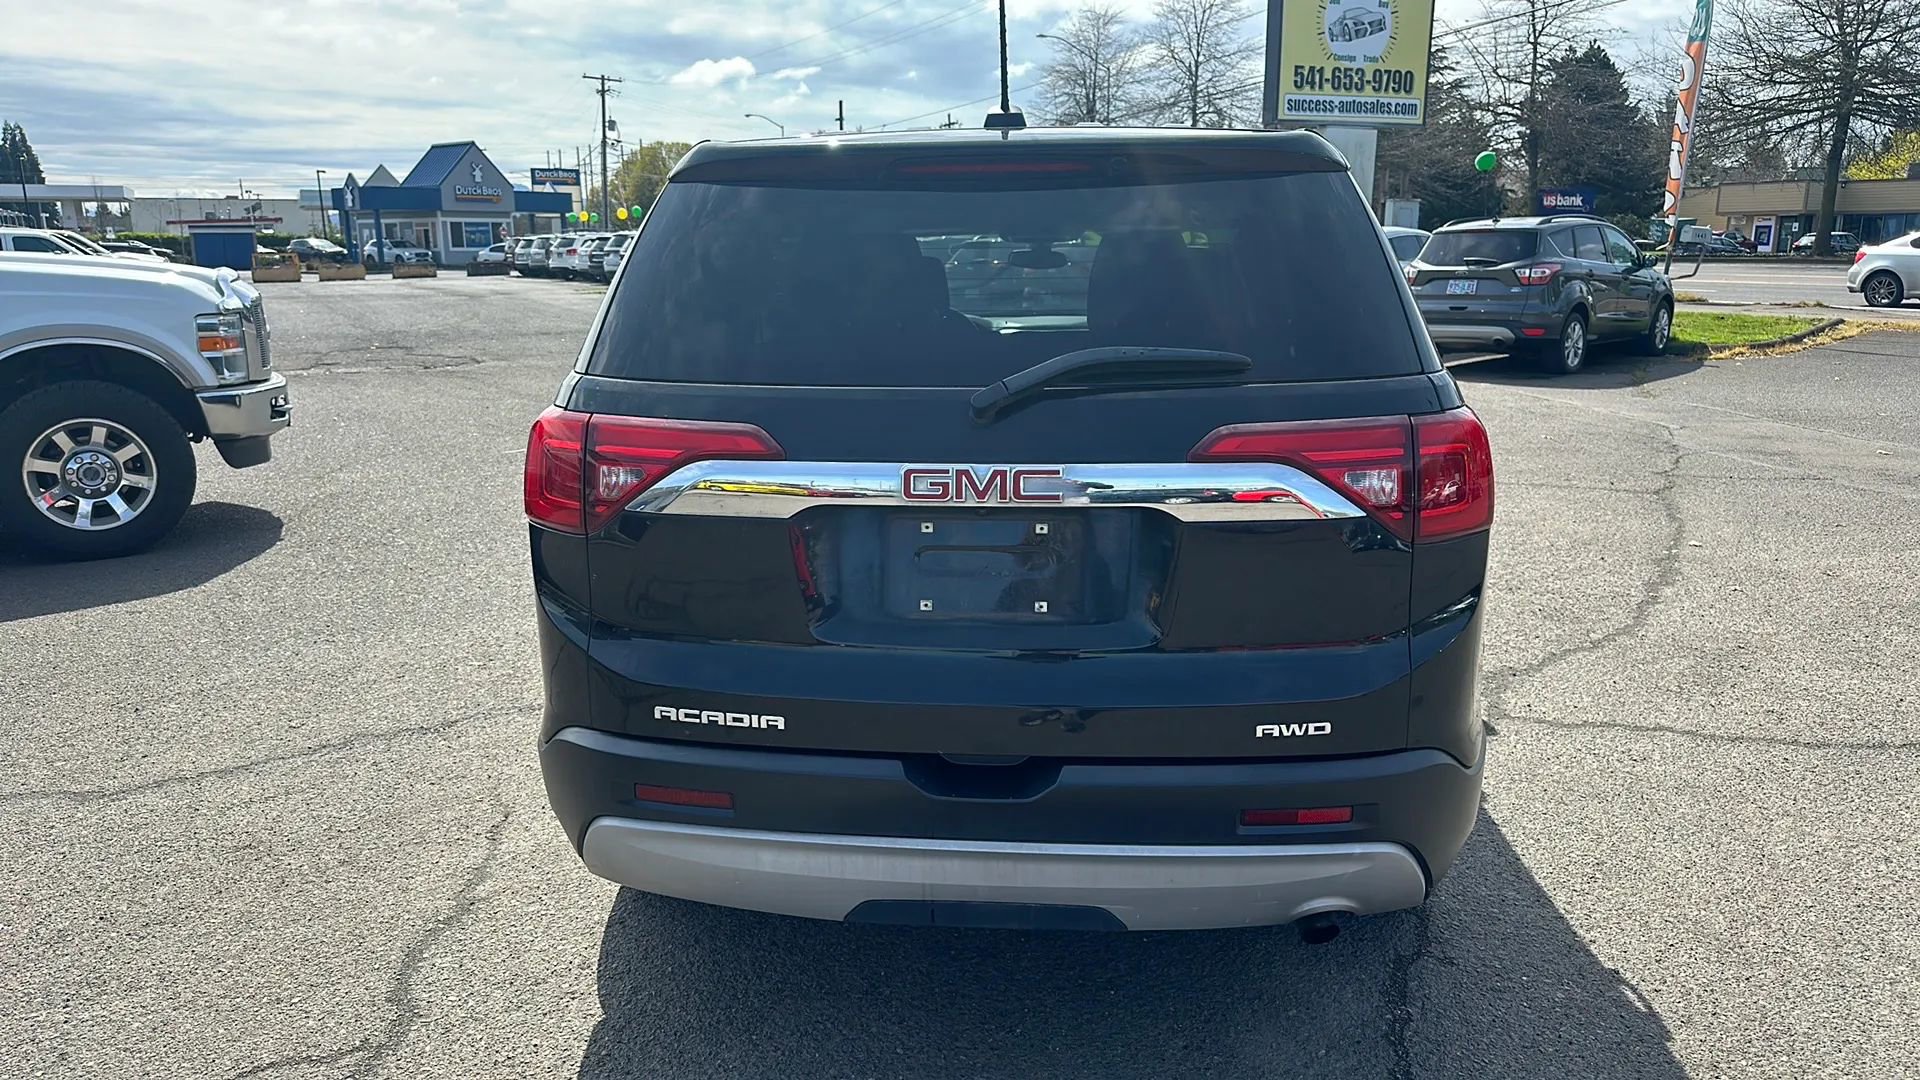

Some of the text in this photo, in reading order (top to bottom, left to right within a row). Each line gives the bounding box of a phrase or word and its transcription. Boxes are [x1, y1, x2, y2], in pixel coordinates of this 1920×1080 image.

[1333, 53, 1380, 63] Consign Trade
[1293, 65, 1415, 94] 541-653-9790
[1286, 98, 1418, 117] success-autosales.com
[901, 465, 1064, 502] GMC
[654, 705, 785, 730] ACADIA
[1255, 722, 1332, 738] AWD
